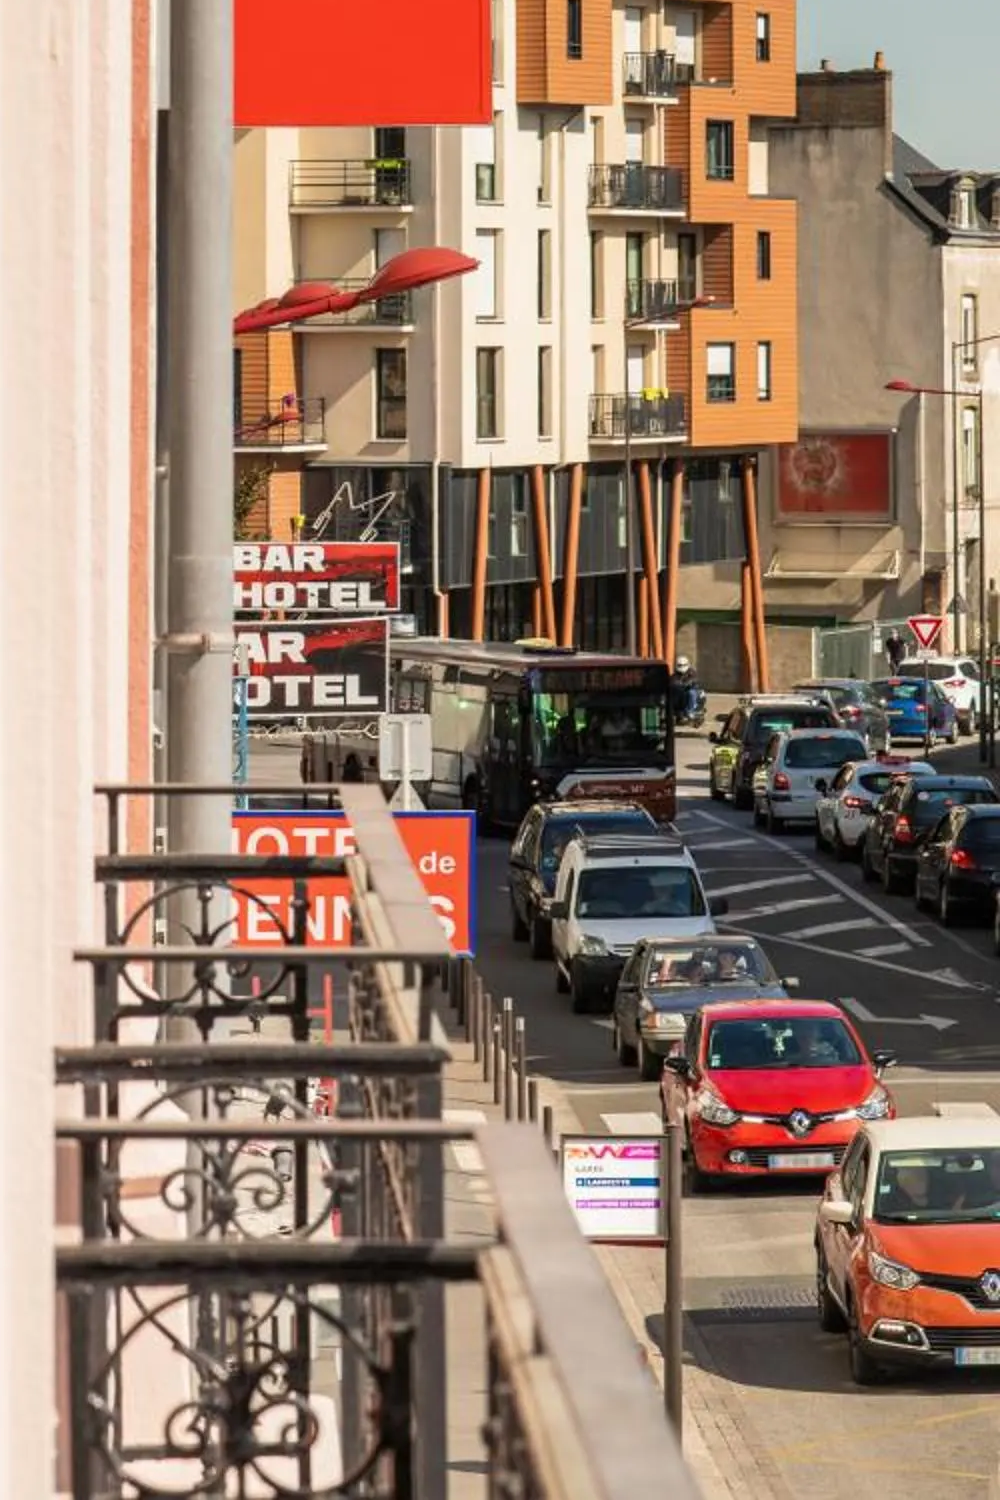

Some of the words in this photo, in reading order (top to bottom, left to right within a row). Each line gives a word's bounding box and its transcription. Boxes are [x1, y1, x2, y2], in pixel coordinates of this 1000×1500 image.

[233, 545, 326, 572] BAR
[233, 581, 387, 609] HOTEL
[234, 631, 307, 663] AR
[235, 674, 380, 707] OTEL
[418, 851, 457, 874] de
